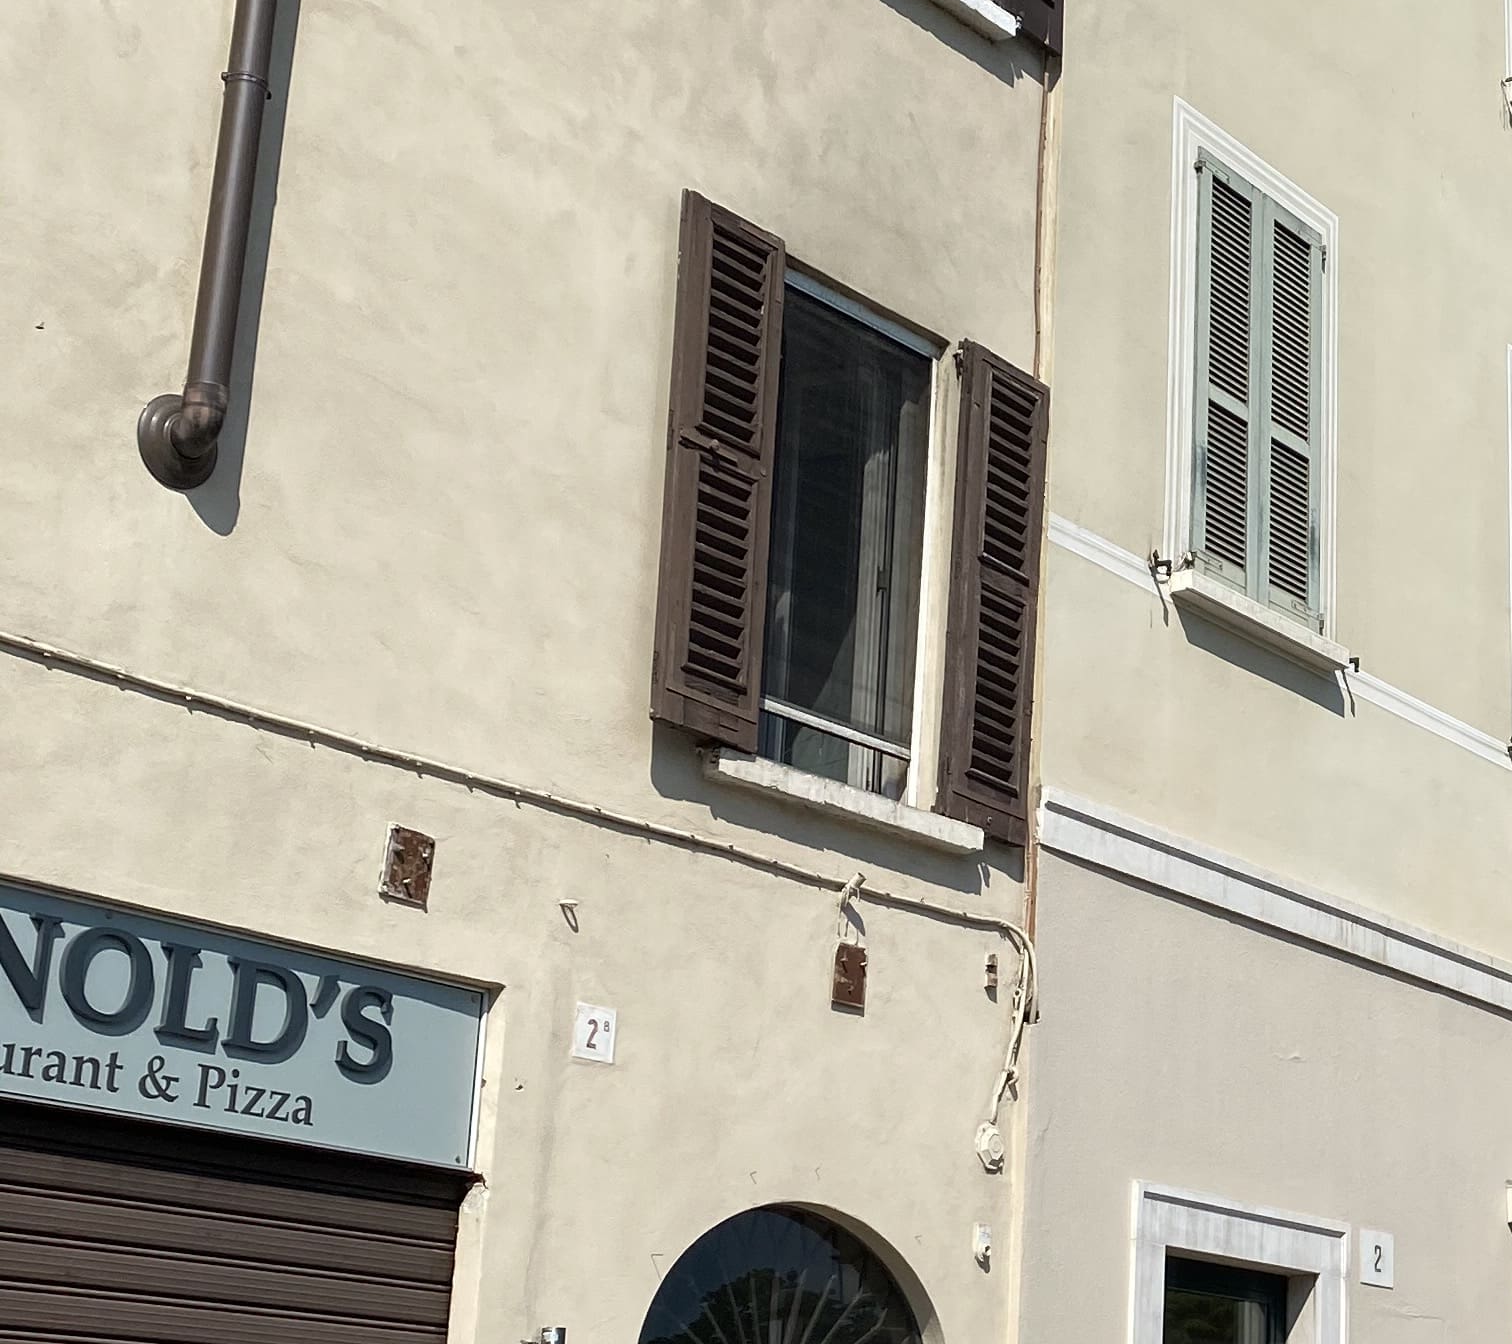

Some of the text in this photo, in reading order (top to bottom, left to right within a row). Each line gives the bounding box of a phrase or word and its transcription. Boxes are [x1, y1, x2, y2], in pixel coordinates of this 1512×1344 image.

[138, 1055, 179, 1103] &
[193, 1063, 314, 1126] Pizza
[1374, 1244, 1382, 1273] 2
